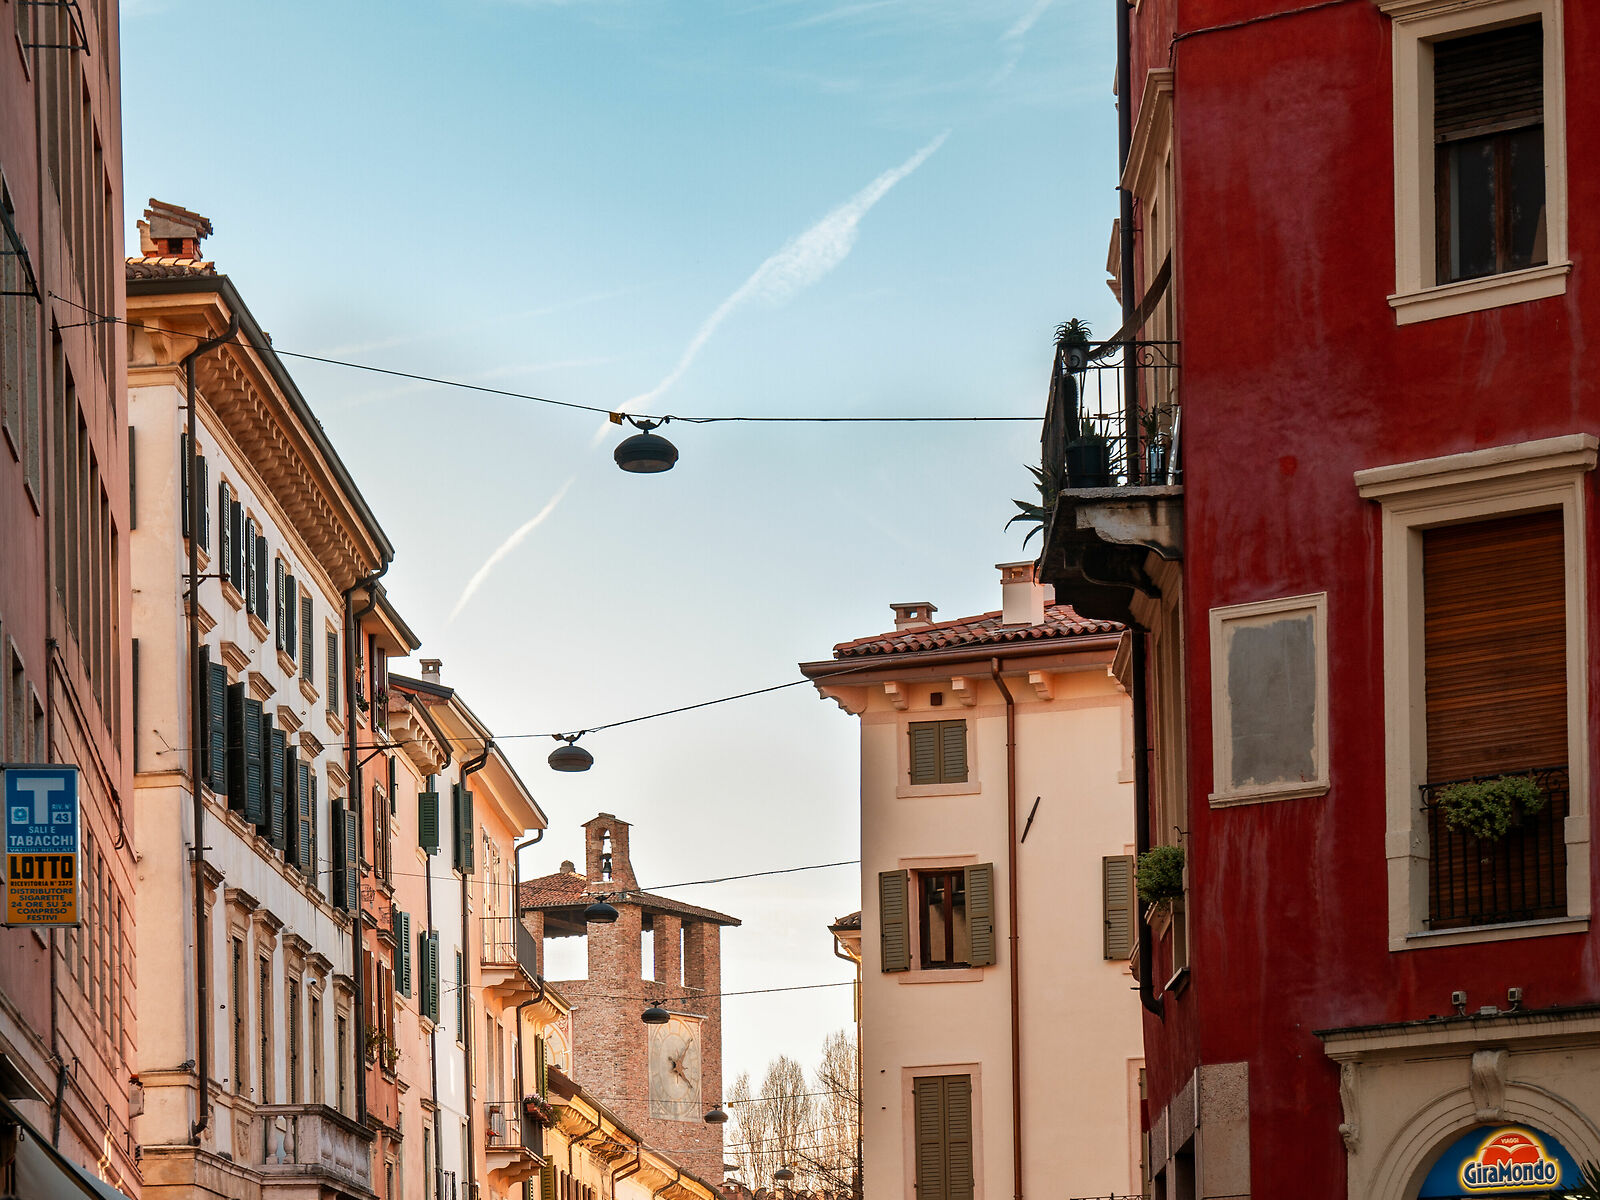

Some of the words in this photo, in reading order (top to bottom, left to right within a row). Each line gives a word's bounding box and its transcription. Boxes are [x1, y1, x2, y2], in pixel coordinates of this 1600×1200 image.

[17, 778, 64, 824] T
[55, 813, 69, 822] 43
[9, 835, 73, 846] TABACCHI
[10, 856, 73, 879] LOTTO
[1463, 1158, 1557, 1184] GiraMondo
